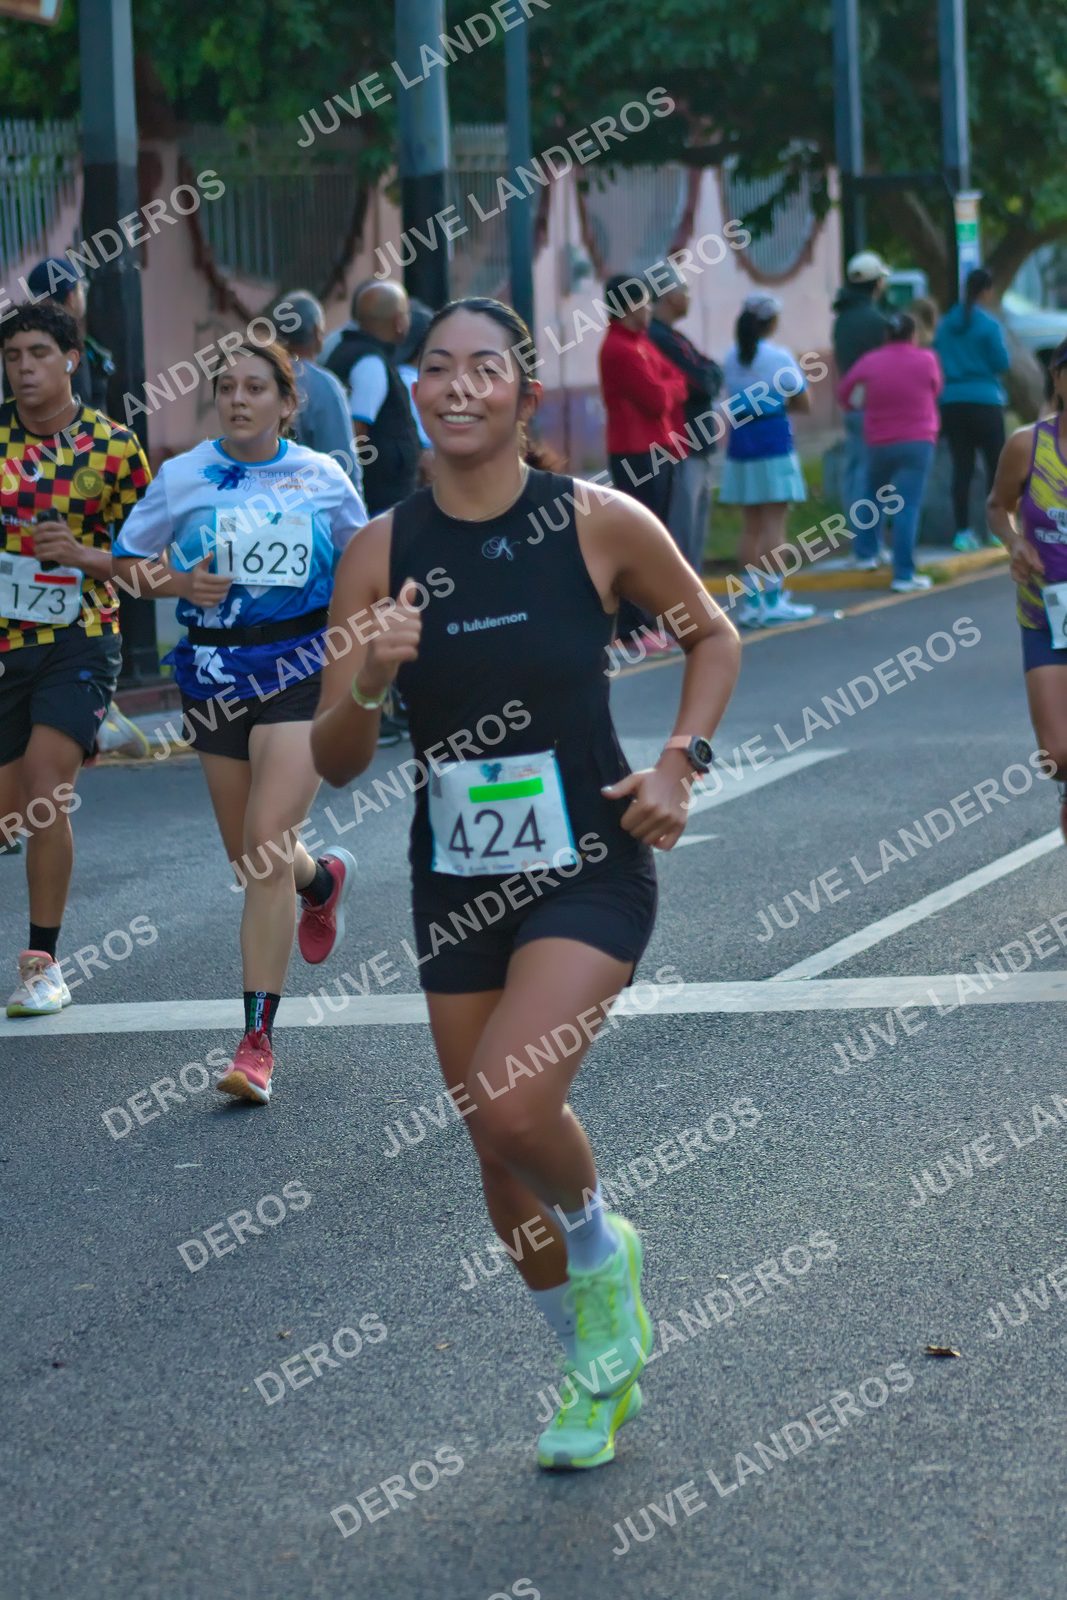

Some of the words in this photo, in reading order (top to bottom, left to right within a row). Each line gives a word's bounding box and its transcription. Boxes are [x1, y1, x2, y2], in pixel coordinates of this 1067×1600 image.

[224, 541, 308, 576] 1623
[12, 583, 66, 615] 173
[463, 611, 528, 632] lululemon
[449, 805, 546, 859] 424
